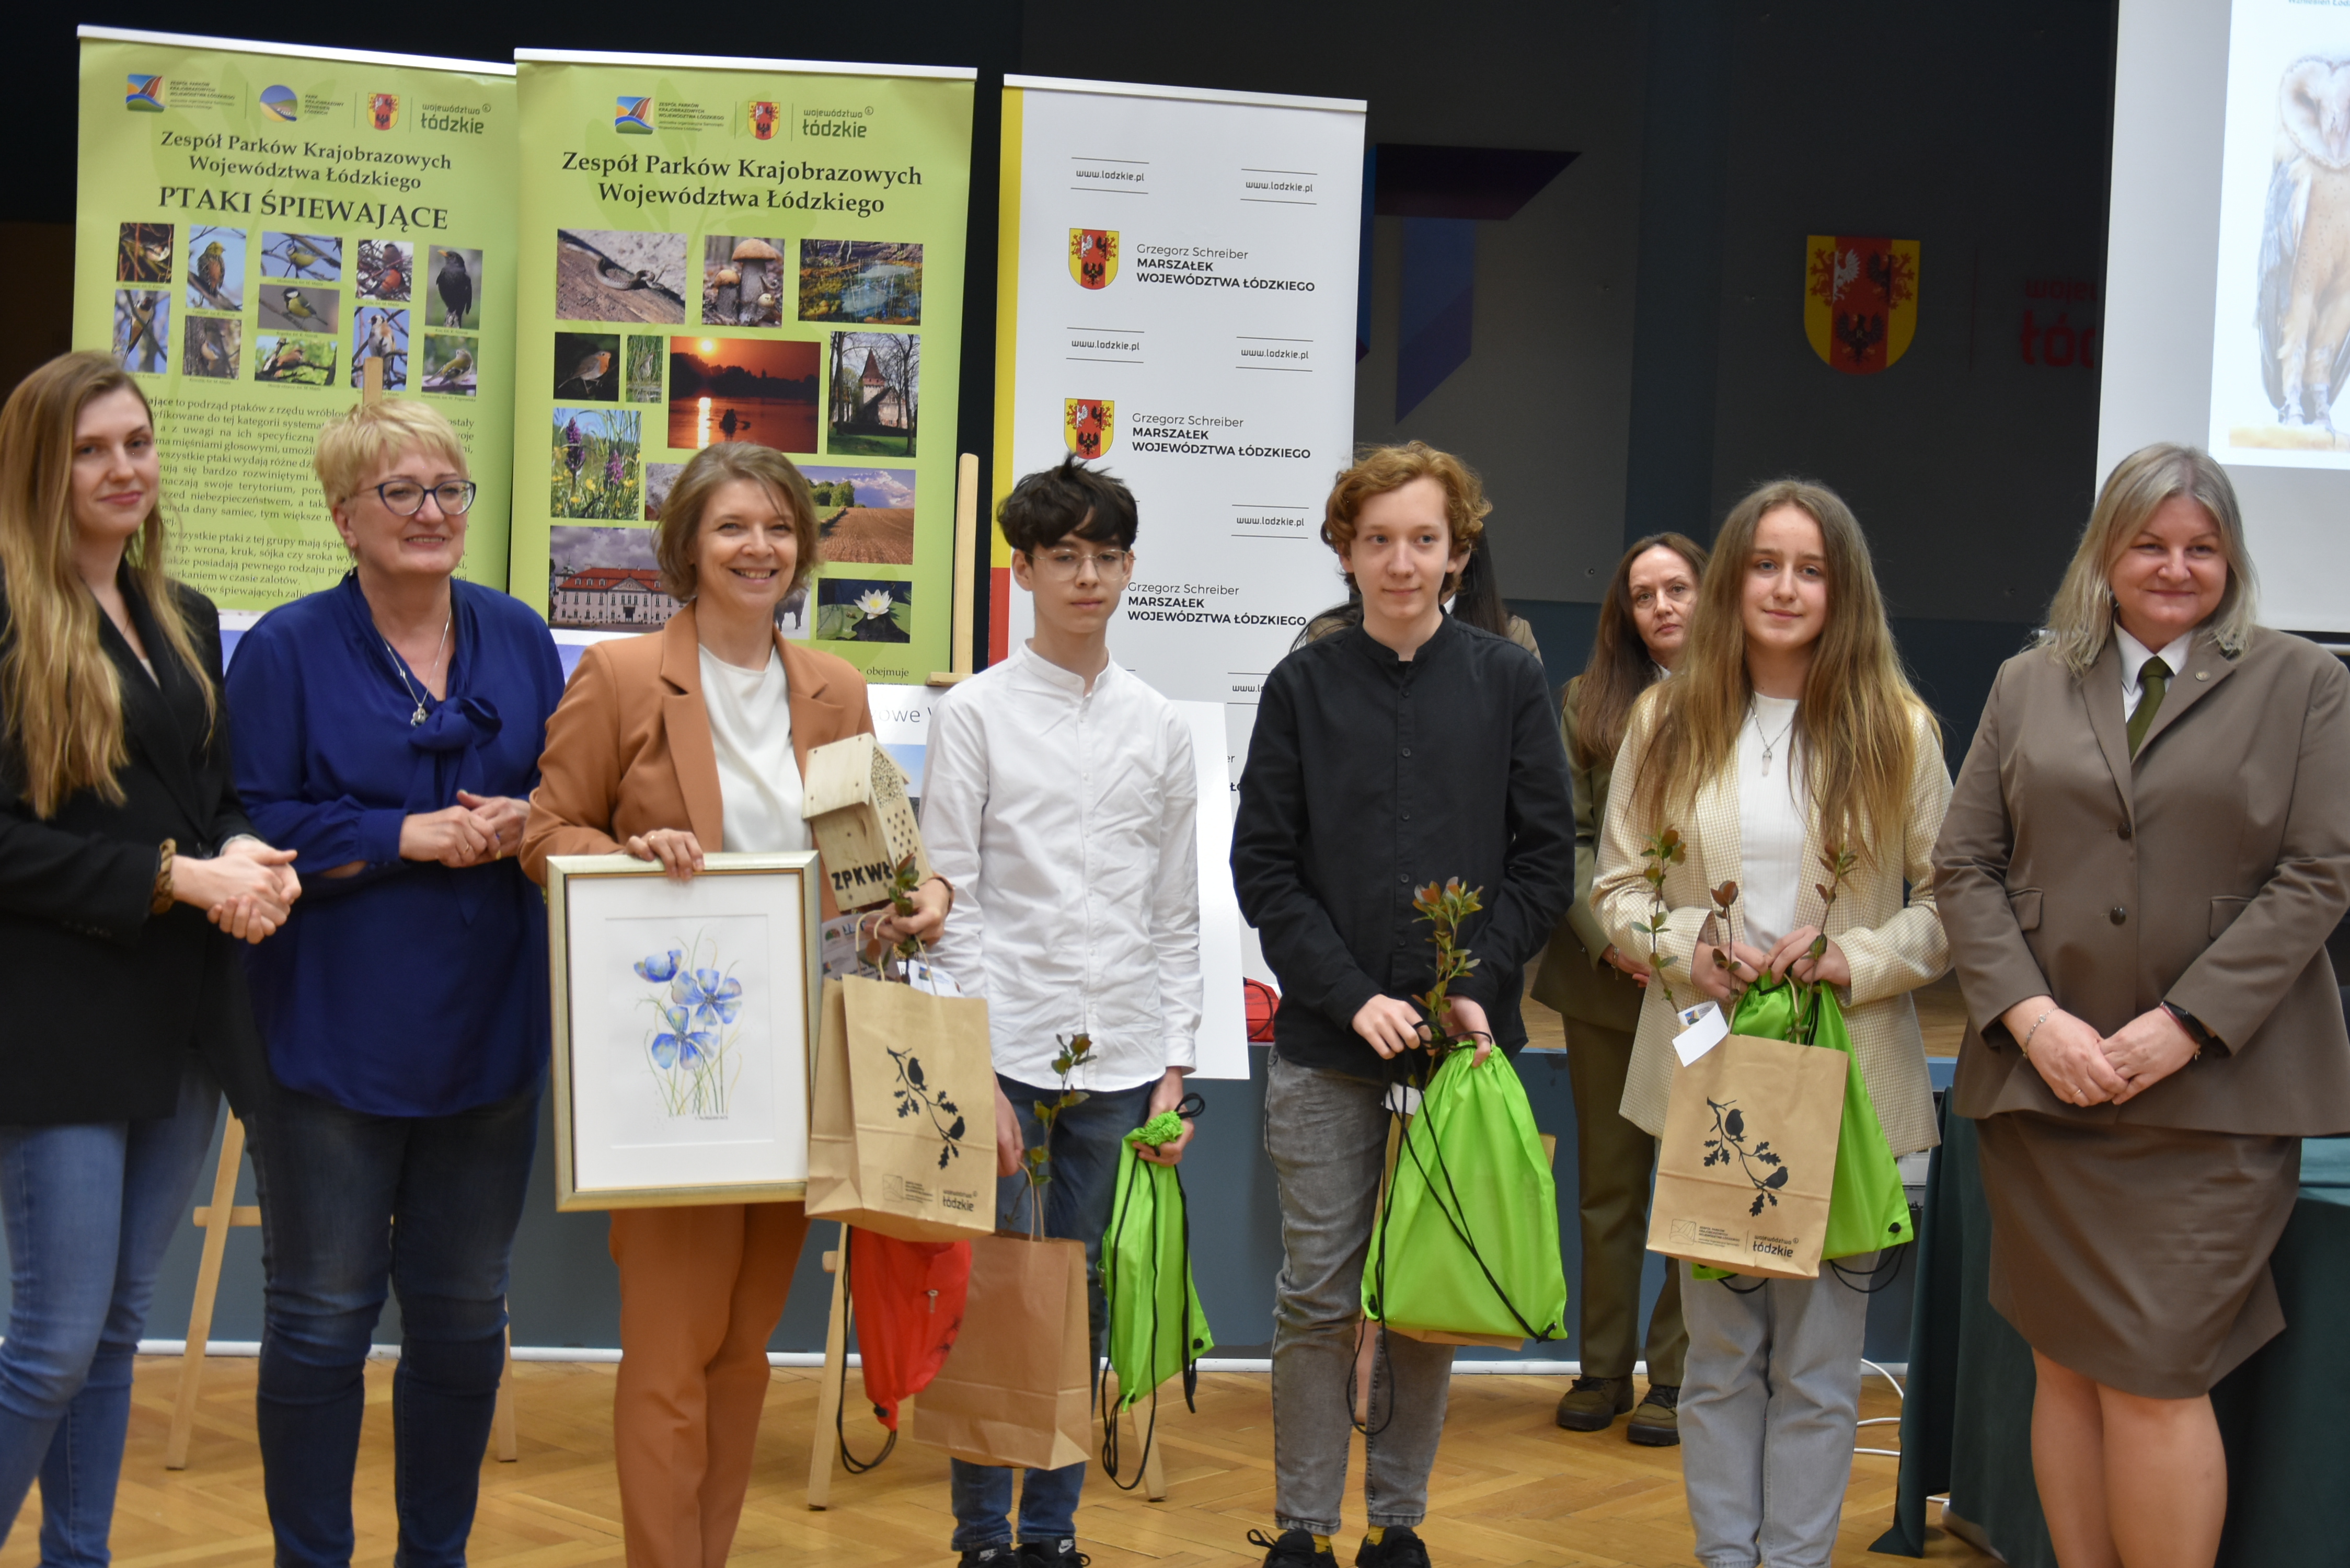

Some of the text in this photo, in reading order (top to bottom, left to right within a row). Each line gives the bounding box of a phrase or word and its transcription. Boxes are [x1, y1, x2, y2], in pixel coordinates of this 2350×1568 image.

[422, 103, 480, 115] województwo
[803, 108, 863, 118] województwo
[421, 113, 484, 134] łódzkie
[802, 119, 867, 138] łódzkie
[160, 131, 451, 171] Zespół Parków Krajobrazowych
[189, 155, 421, 193] Województwa Łódzkiego
[561, 151, 922, 189] Zespół Parków Krajobrazowych
[1076, 169, 1145, 182] www.lodzkie.pl
[1246, 180, 1313, 193] www.lodzkie.pl
[598, 182, 884, 218] Województwa Łódzkiego
[158, 186, 448, 233] PTAKI ŚPIEWAJĄCE
[1137, 244, 1249, 260] Grzegorz Schreiber
[1137, 258, 1213, 272] MARSZAŁEK
[1137, 272, 1315, 292] WOJEWÓDZTWA ŁÓDZKIEGO
[1071, 339, 1140, 352] www.lodzkie.pl
[1241, 348, 1309, 361] www.lodzkie.pl
[147, 396, 173, 407] ające
[176, 398, 185, 407] to
[188, 400, 228, 411] podrząd
[231, 403, 267, 413] ptaków
[277, 406, 304, 417] rzędu
[208, 413, 220, 423] do
[223, 416, 235, 426] tej
[238, 416, 280, 428] kategorii
[1132, 412, 1244, 428] Grzegorz Schreiber
[183, 428, 214, 437] uwagi
[238, 429, 251, 439] ich
[258, 432, 314, 444] specyficzną
[1133, 427, 1208, 441] MARSZAŁEK
[172, 439, 222, 449] mięśniami
[224, 443, 280, 454] głosowymi,
[1132, 441, 1311, 459] WOJEWÓDZTWA ŁÓDZKIEGO
[157, 452, 204, 462] wszystkie
[206, 454, 231, 464] ptaki
[234, 455, 268, 467] wydają
[270, 458, 297, 467] różne
[183, 465, 197, 475] się
[203, 466, 237, 476] bardzo
[243, 470, 308, 482] rozwiniętymi
[204, 481, 233, 491] swoje
[239, 482, 295, 494] terytorium,
[191, 492, 293, 507] niebezpieczeństwem,
[193, 505, 217, 517] dany
[221, 508, 257, 518] samiec,
[260, 510, 279, 520] tym
[283, 512, 321, 522] większe
[1237, 516, 1305, 527] www.lodzkie.pl
[170, 531, 217, 542] wszystkie
[220, 533, 243, 544] ptaki
[254, 535, 264, 545] tej
[267, 537, 295, 548] grupy
[298, 539, 320, 549] mają
[194, 547, 227, 555] wrona,
[231, 547, 256, 557] kruk,
[260, 548, 283, 559] sójka
[287, 552, 303, 562] czy
[306, 552, 332, 561] sroka
[193, 558, 238, 570] posiadają
[241, 562, 285, 573] pewnego
[289, 564, 325, 575] rodzaju
[229, 574, 258, 583] czasie
[260, 575, 301, 585] zalotów.
[220, 585, 283, 599] śpiewających
[1127, 582, 1240, 596] Grzegorz Schreiber
[1128, 596, 1204, 609] MARSZAŁEK
[1127, 609, 1307, 626] WOJEWÓDZTWA ŁÓDZKIEGO
[867, 666, 909, 678] obejmuje
[832, 861, 893, 891] ZPKWŁ
[942, 1195, 974, 1212] łódzkie
[1754, 1234, 1792, 1245] województwo
[1753, 1241, 1793, 1258] łódzkie
